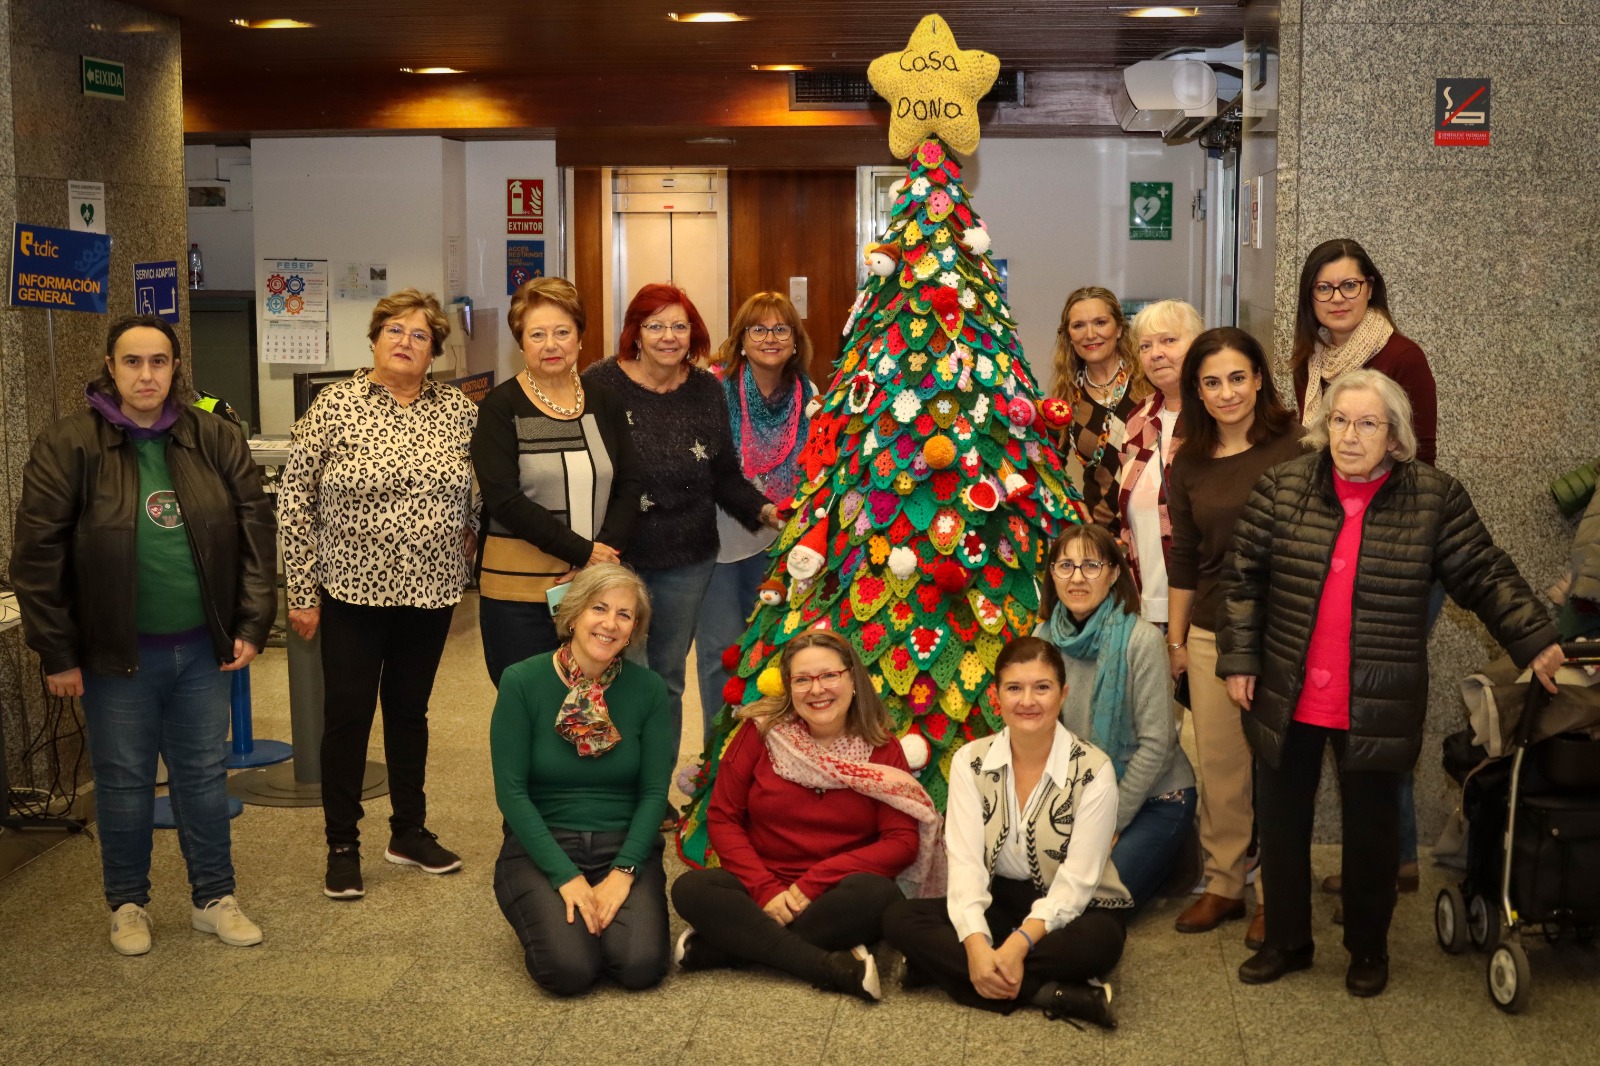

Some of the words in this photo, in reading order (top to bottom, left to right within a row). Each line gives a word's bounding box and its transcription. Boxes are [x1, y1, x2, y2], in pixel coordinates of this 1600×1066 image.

[94, 69, 123, 89] EIXIDA
[508, 221, 543, 231] EXTINTOR
[276, 261, 314, 269] FESEP
[136, 269, 155, 280] SERVICI
[155, 267, 177, 279] ADAPTAT
[18, 273, 101, 294] INFORMACIÓN
[18, 288, 76, 305] GENERAL
